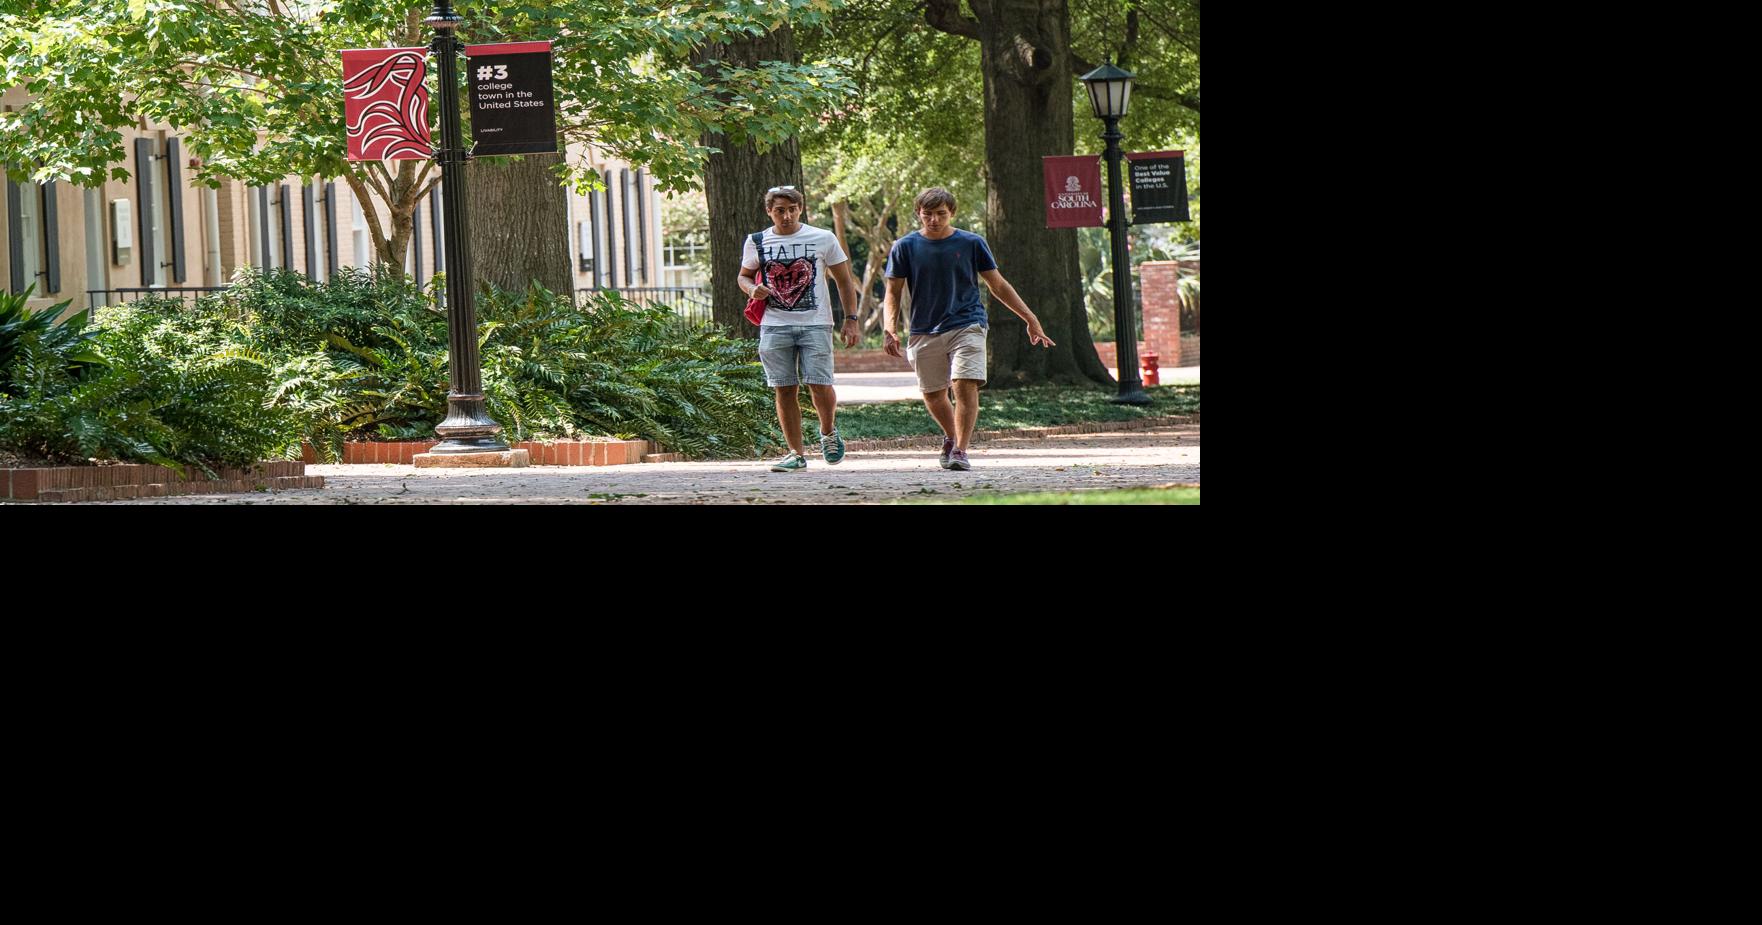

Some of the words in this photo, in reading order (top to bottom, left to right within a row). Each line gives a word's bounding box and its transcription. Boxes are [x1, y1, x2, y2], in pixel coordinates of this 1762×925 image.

[477, 64, 509, 80] #3
[477, 82, 513, 91] college
[505, 91, 515, 99] in
[516, 90, 533, 98] the
[479, 101, 511, 110] United
[513, 100, 545, 108] States
[1057, 194, 1090, 202] SOUTH
[1050, 200, 1098, 209] CAROLINA
